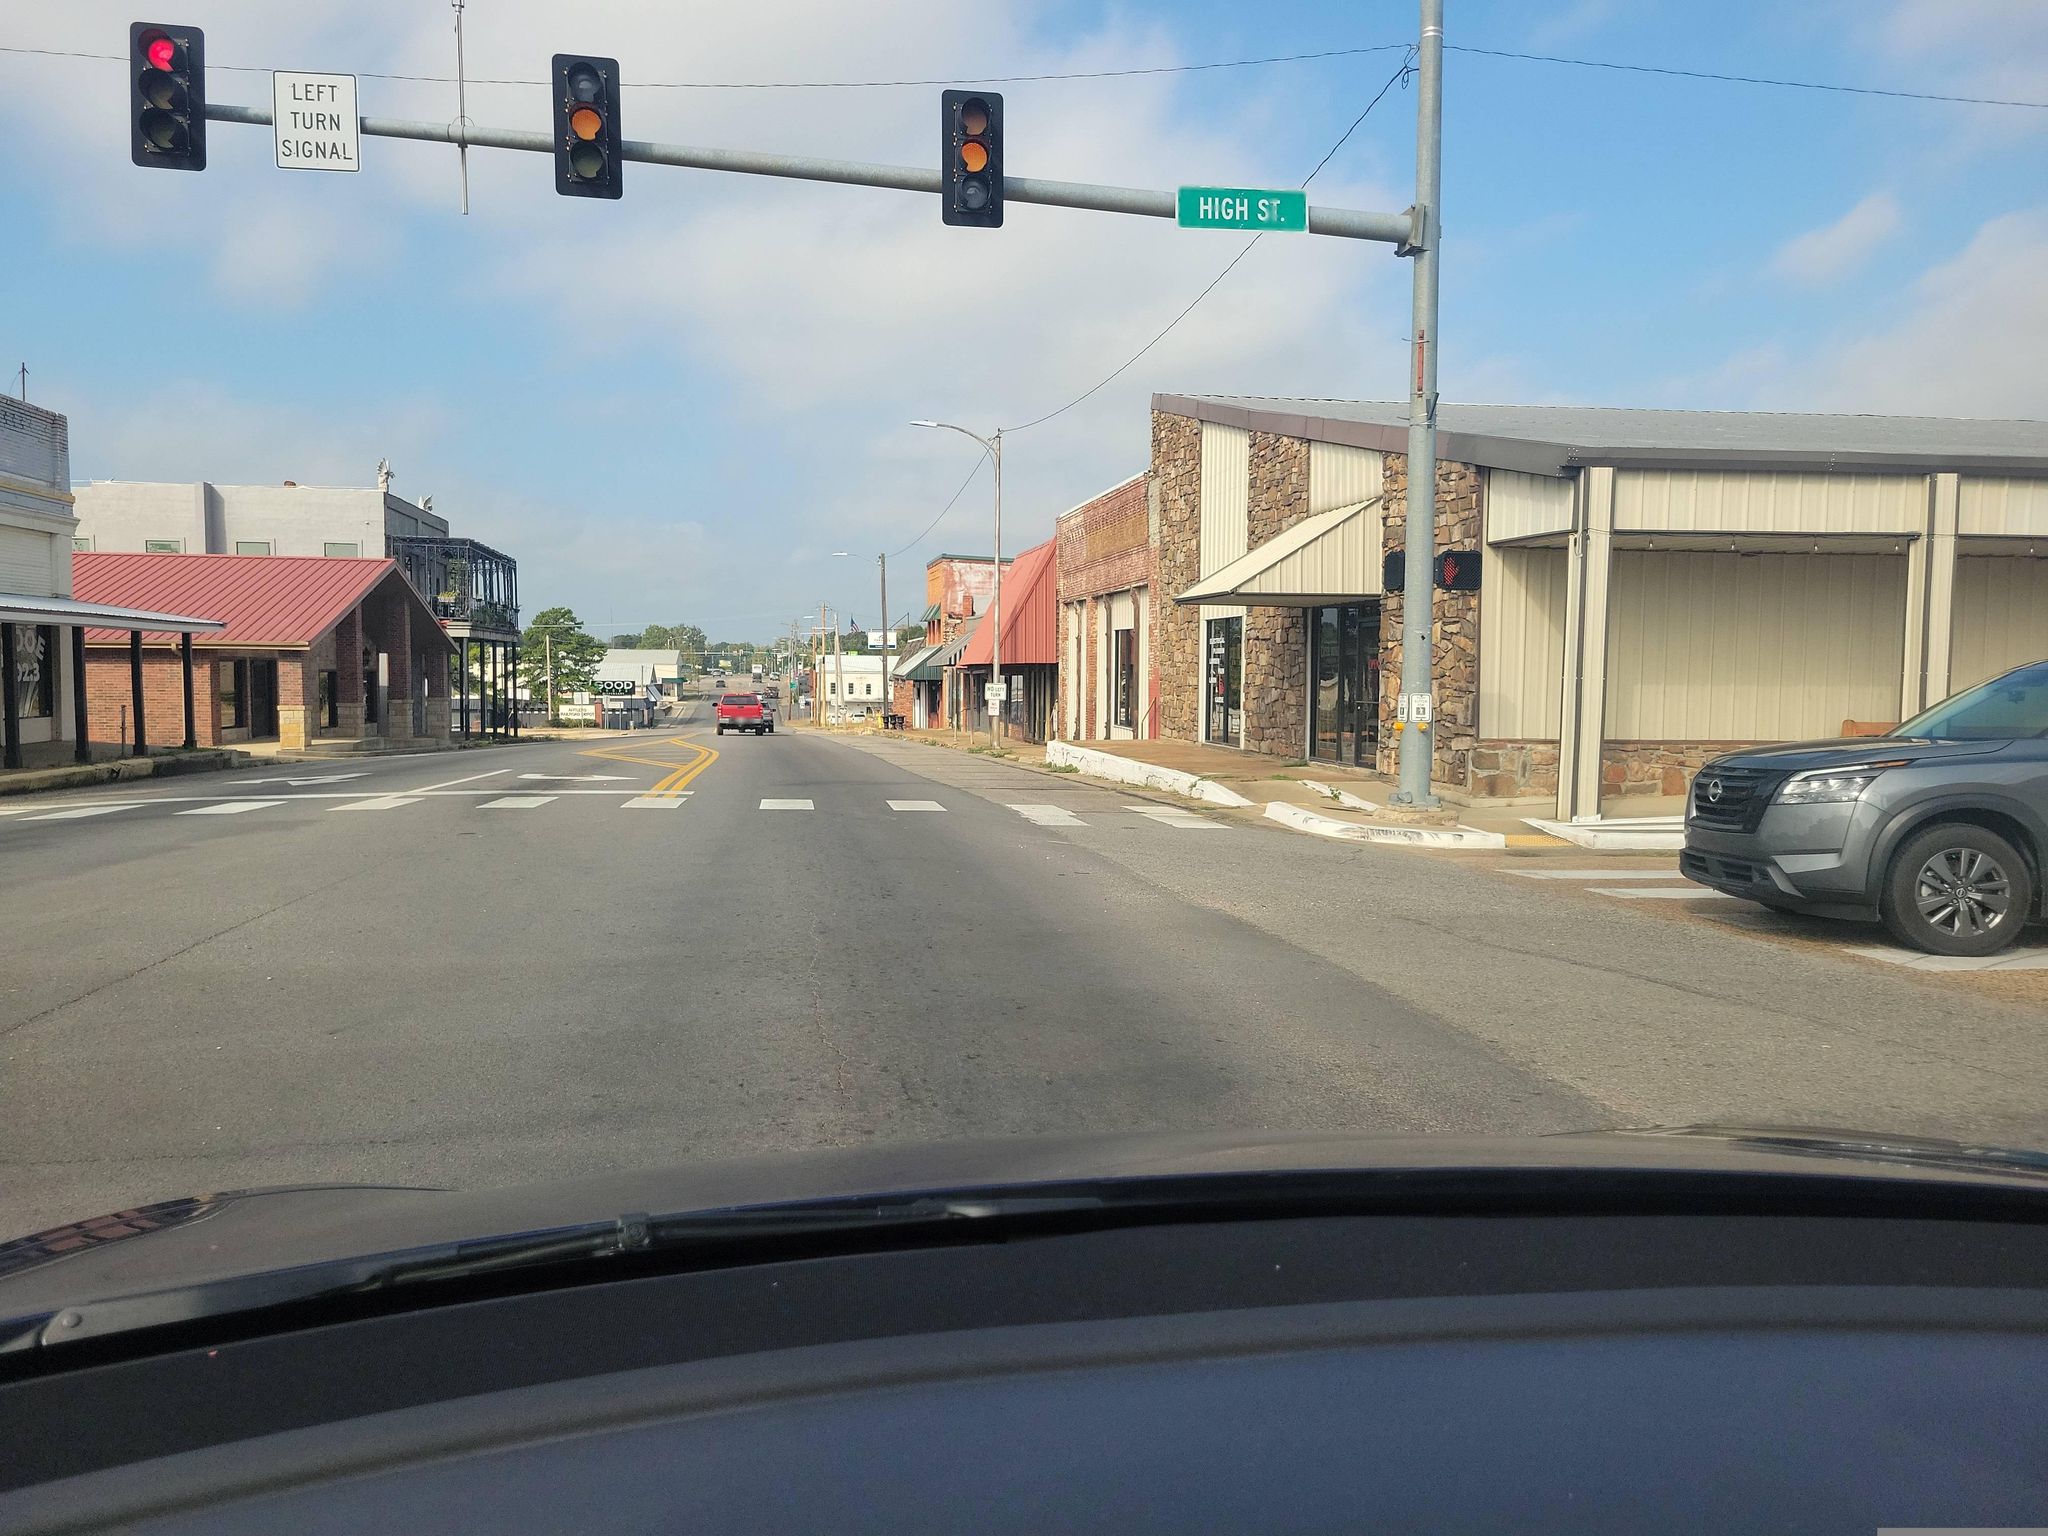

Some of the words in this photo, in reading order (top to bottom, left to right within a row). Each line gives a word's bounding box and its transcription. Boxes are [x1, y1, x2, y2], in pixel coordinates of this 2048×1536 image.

[292, 83, 338, 102] LEFT
[290, 112, 341, 131] TURN
[281, 139, 353, 160] SIGNAL
[1199, 196, 1249, 221] HIGH
[1257, 198, 1285, 222] ST.
